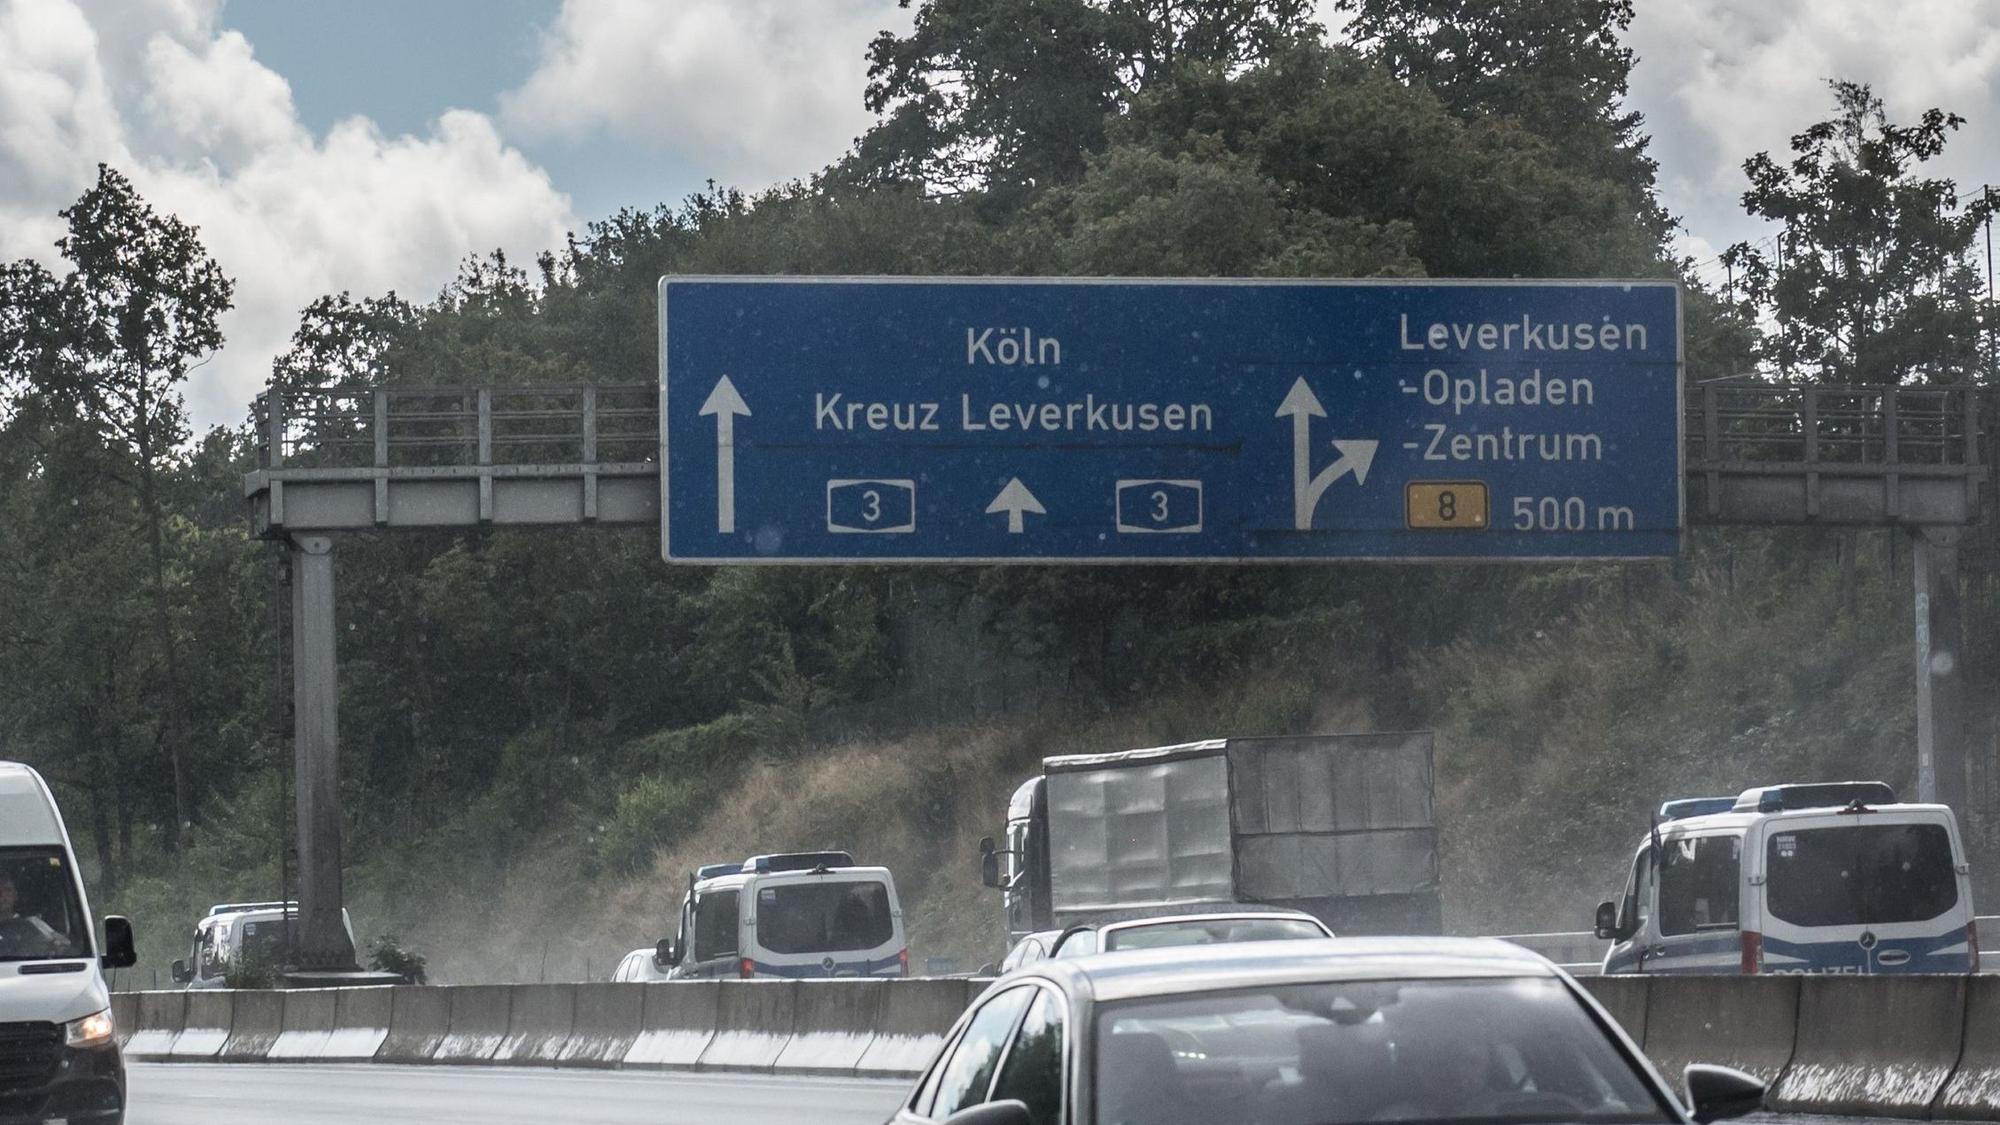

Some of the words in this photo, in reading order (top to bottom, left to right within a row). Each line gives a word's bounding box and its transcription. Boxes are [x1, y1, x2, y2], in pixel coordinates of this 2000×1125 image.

[968, 327, 1061, 365] Köln
[1401, 313, 1647, 350] Leverkusen
[1402, 369, 1594, 415] -Opladen
[815, 393, 939, 430] Kreuz
[962, 393, 1212, 430] Leverkusen
[1403, 423, 1601, 461] -Zentrum
[862, 491, 881, 520] 3
[1149, 491, 1168, 520] 3
[1438, 491, 1457, 521] 8
[1512, 496, 1586, 531] 500
[1597, 506, 1635, 531] m
